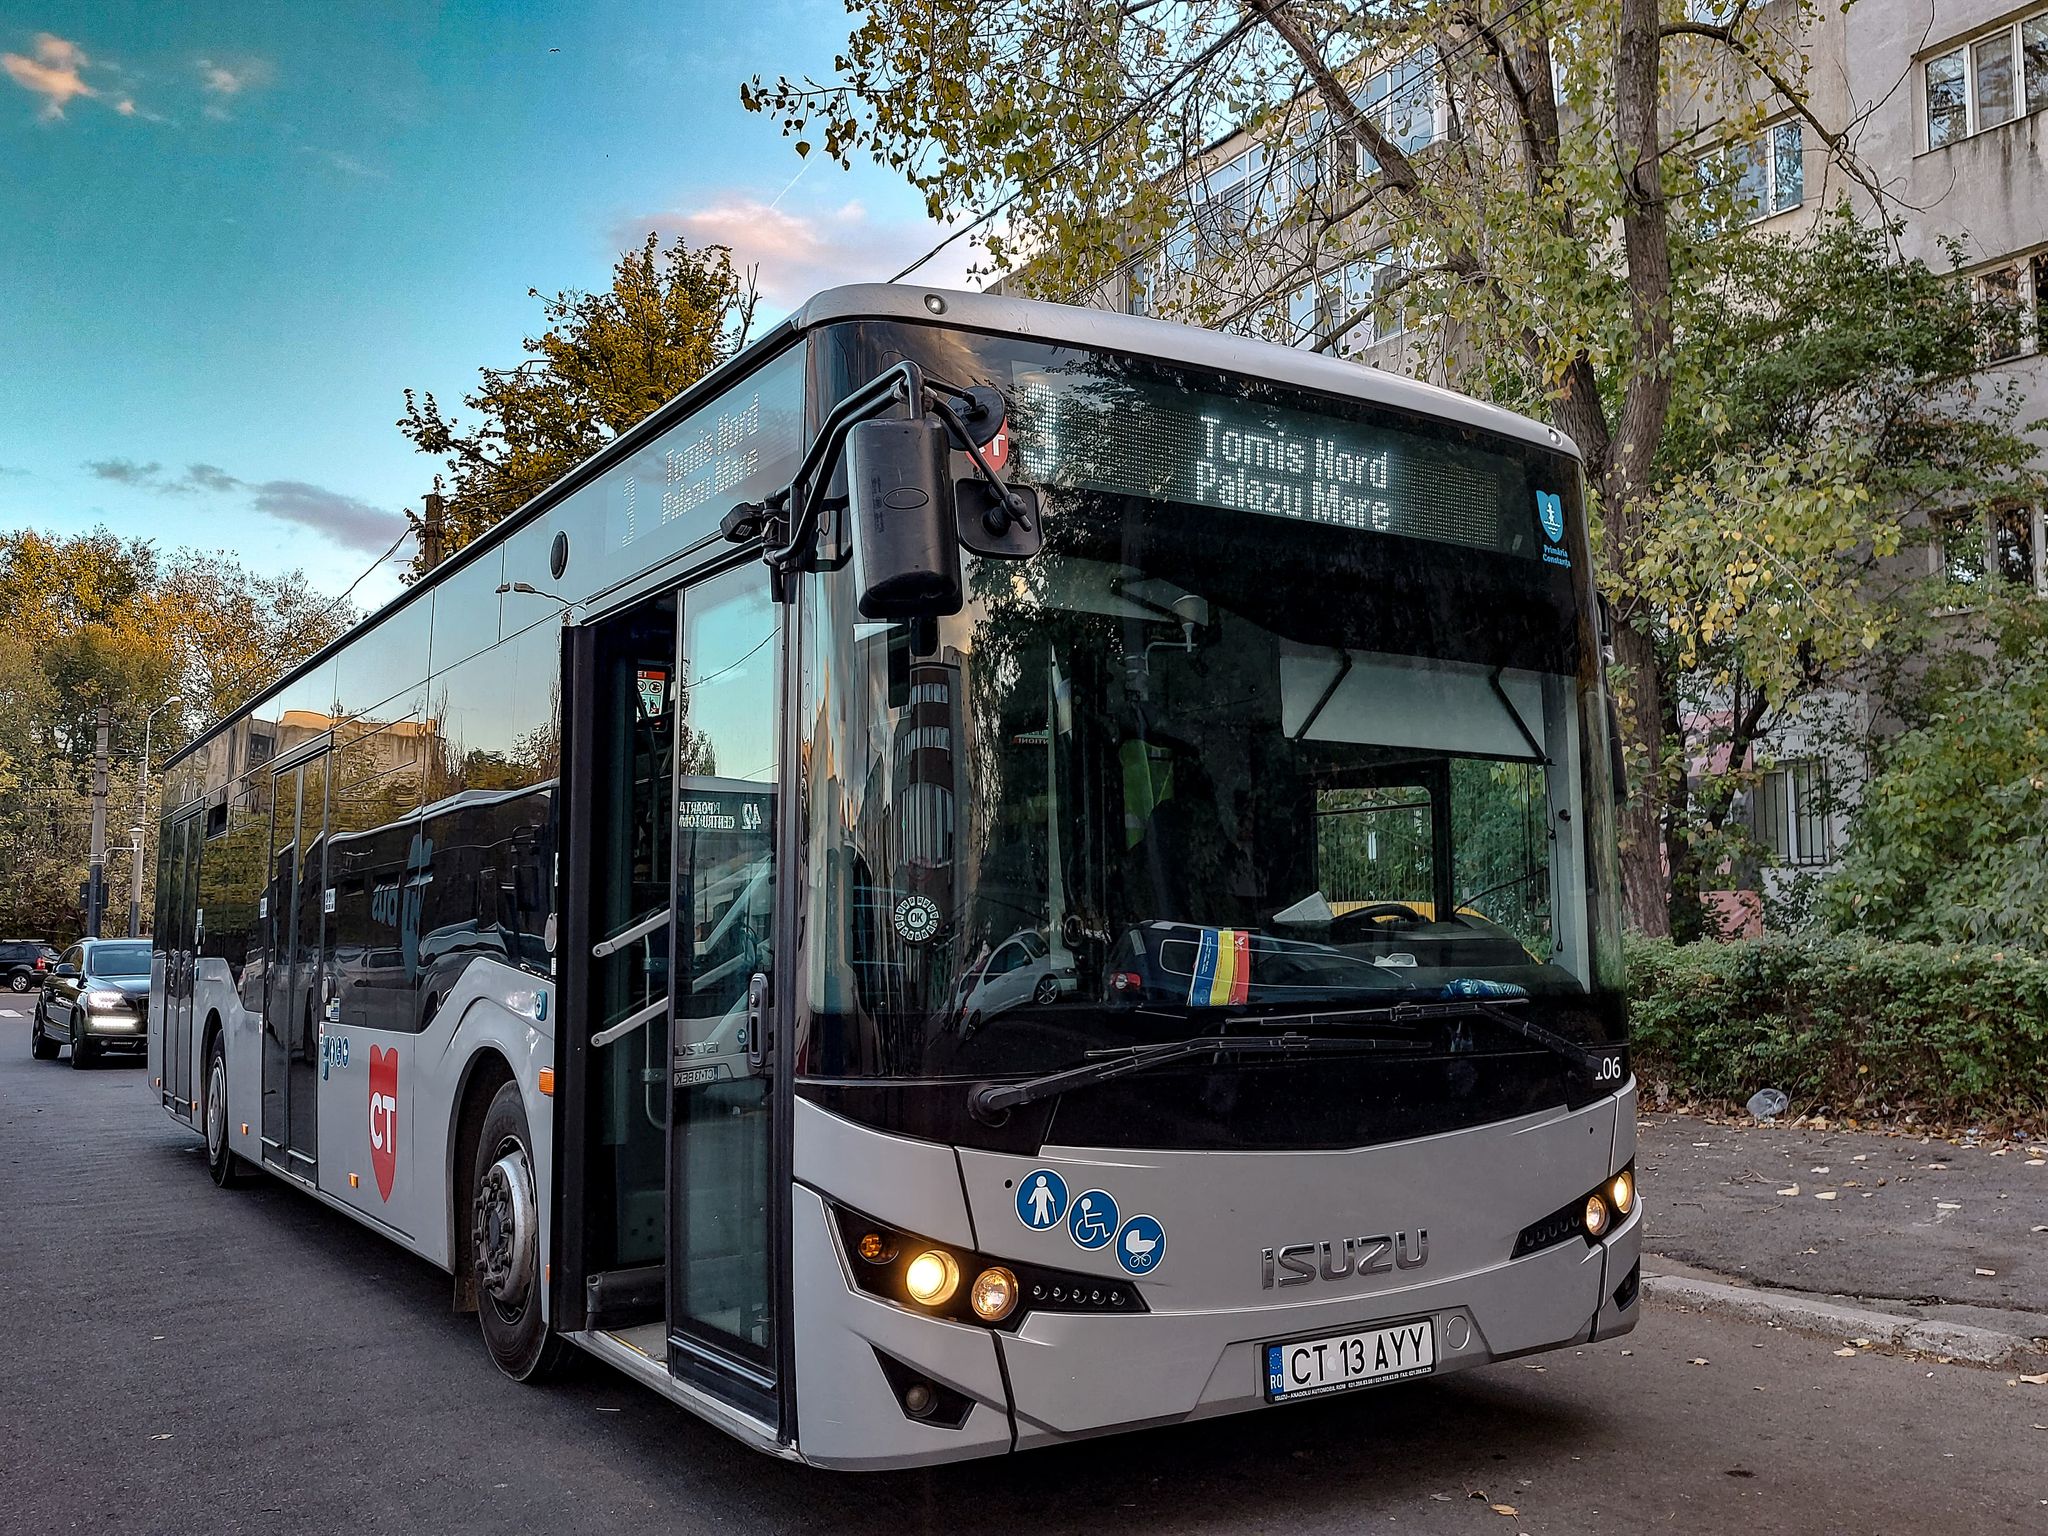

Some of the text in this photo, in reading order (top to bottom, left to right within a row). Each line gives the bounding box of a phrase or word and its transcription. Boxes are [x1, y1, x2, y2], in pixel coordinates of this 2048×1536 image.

[1200, 415, 1388, 489] Tomis Nord
[1195, 461, 1390, 531] Palazu Mare
[910, 912, 923, 923] OK
[369, 1091, 395, 1154] CT
[1261, 1227, 1429, 1289] ISUZU
[1270, 1374, 1283, 1390] RO
[1291, 1326, 1425, 1385] CT 13 AYY
